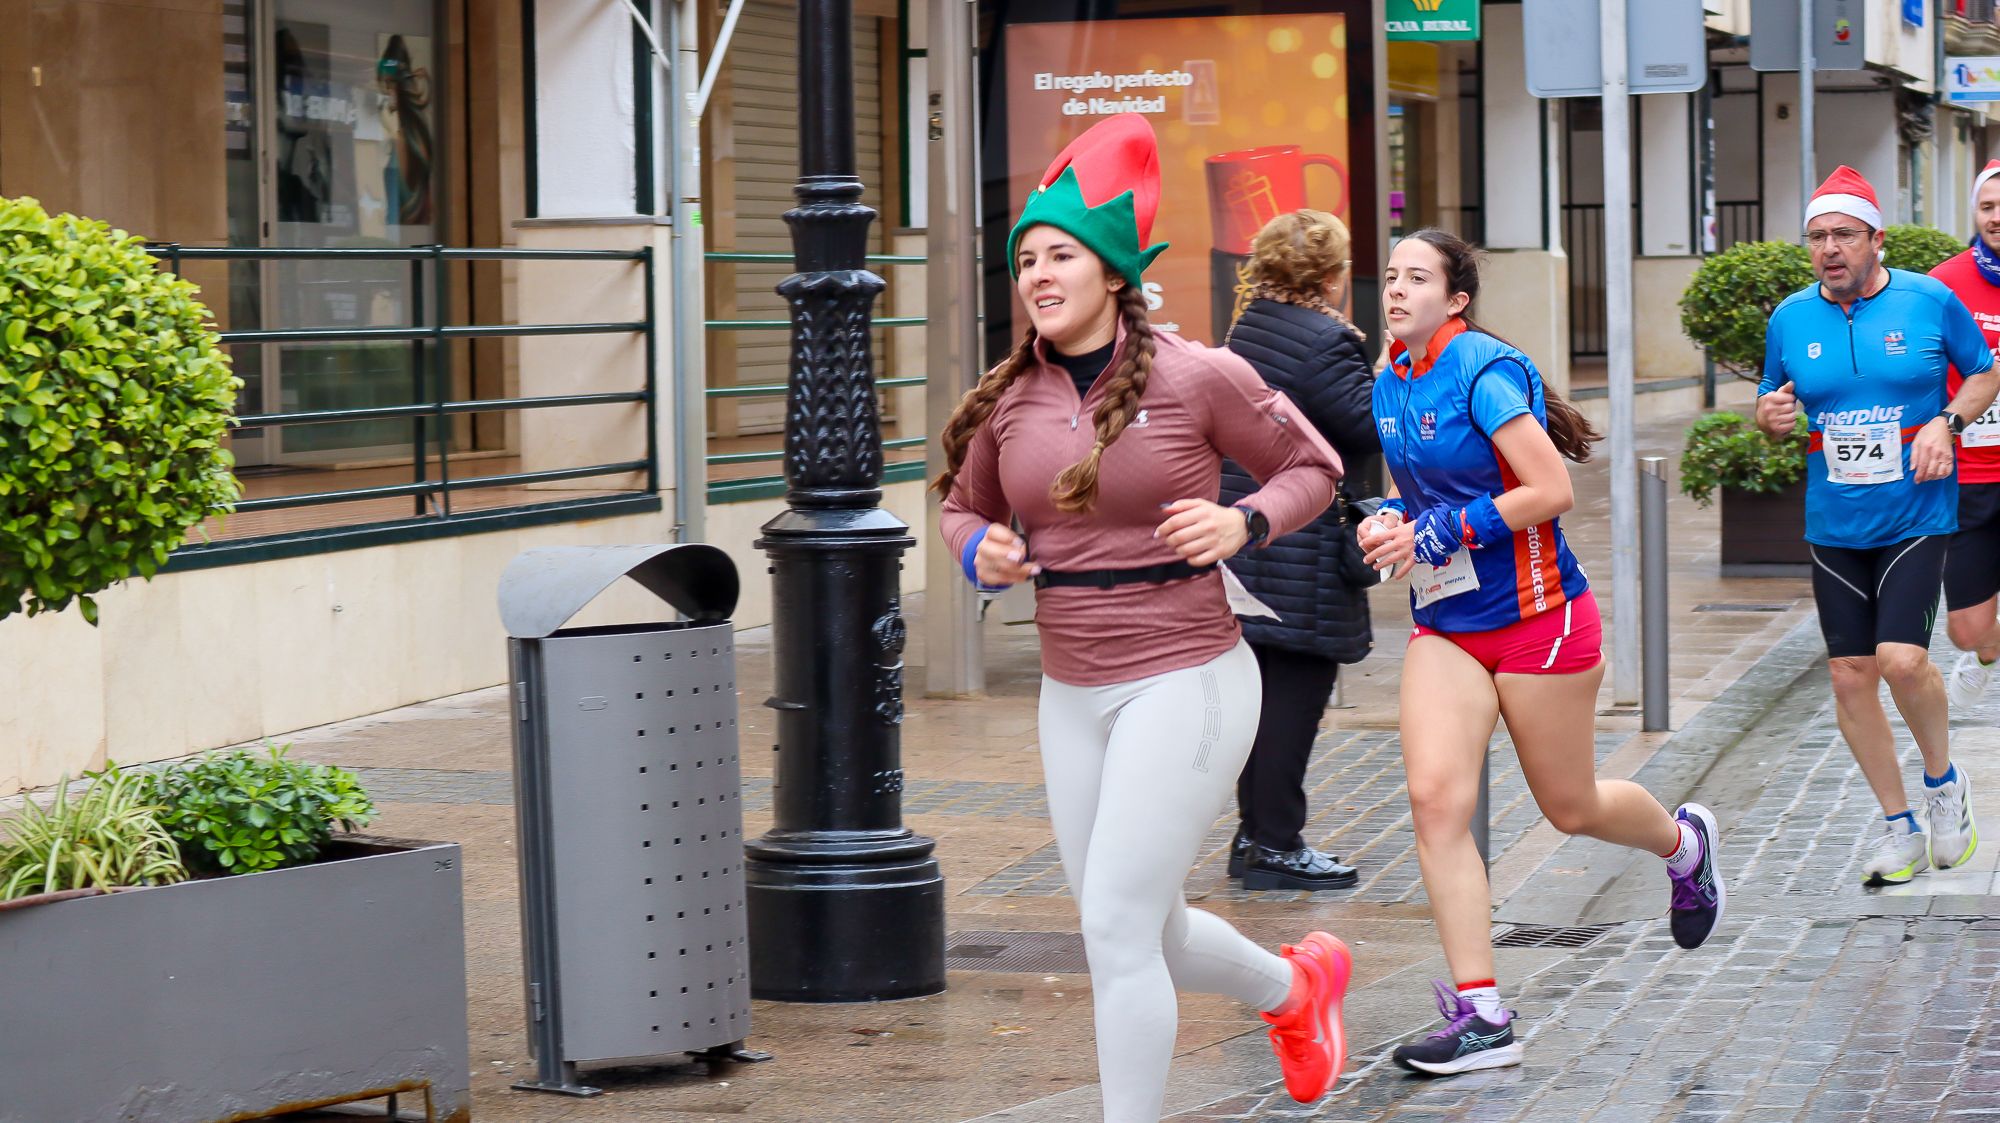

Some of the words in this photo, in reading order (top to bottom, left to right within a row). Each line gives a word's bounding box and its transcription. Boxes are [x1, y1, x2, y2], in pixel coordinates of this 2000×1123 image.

[1384, 20, 1420, 32] CAJA
[1034, 72, 1053, 90] El
[1054, 71, 1112, 94] regalo
[1114, 70, 1194, 93] perfecto
[1062, 98, 1088, 115] de
[1089, 96, 1166, 115] Navidad
[1816, 405, 1905, 426] enerplus
[1837, 444, 1884, 462] 574
